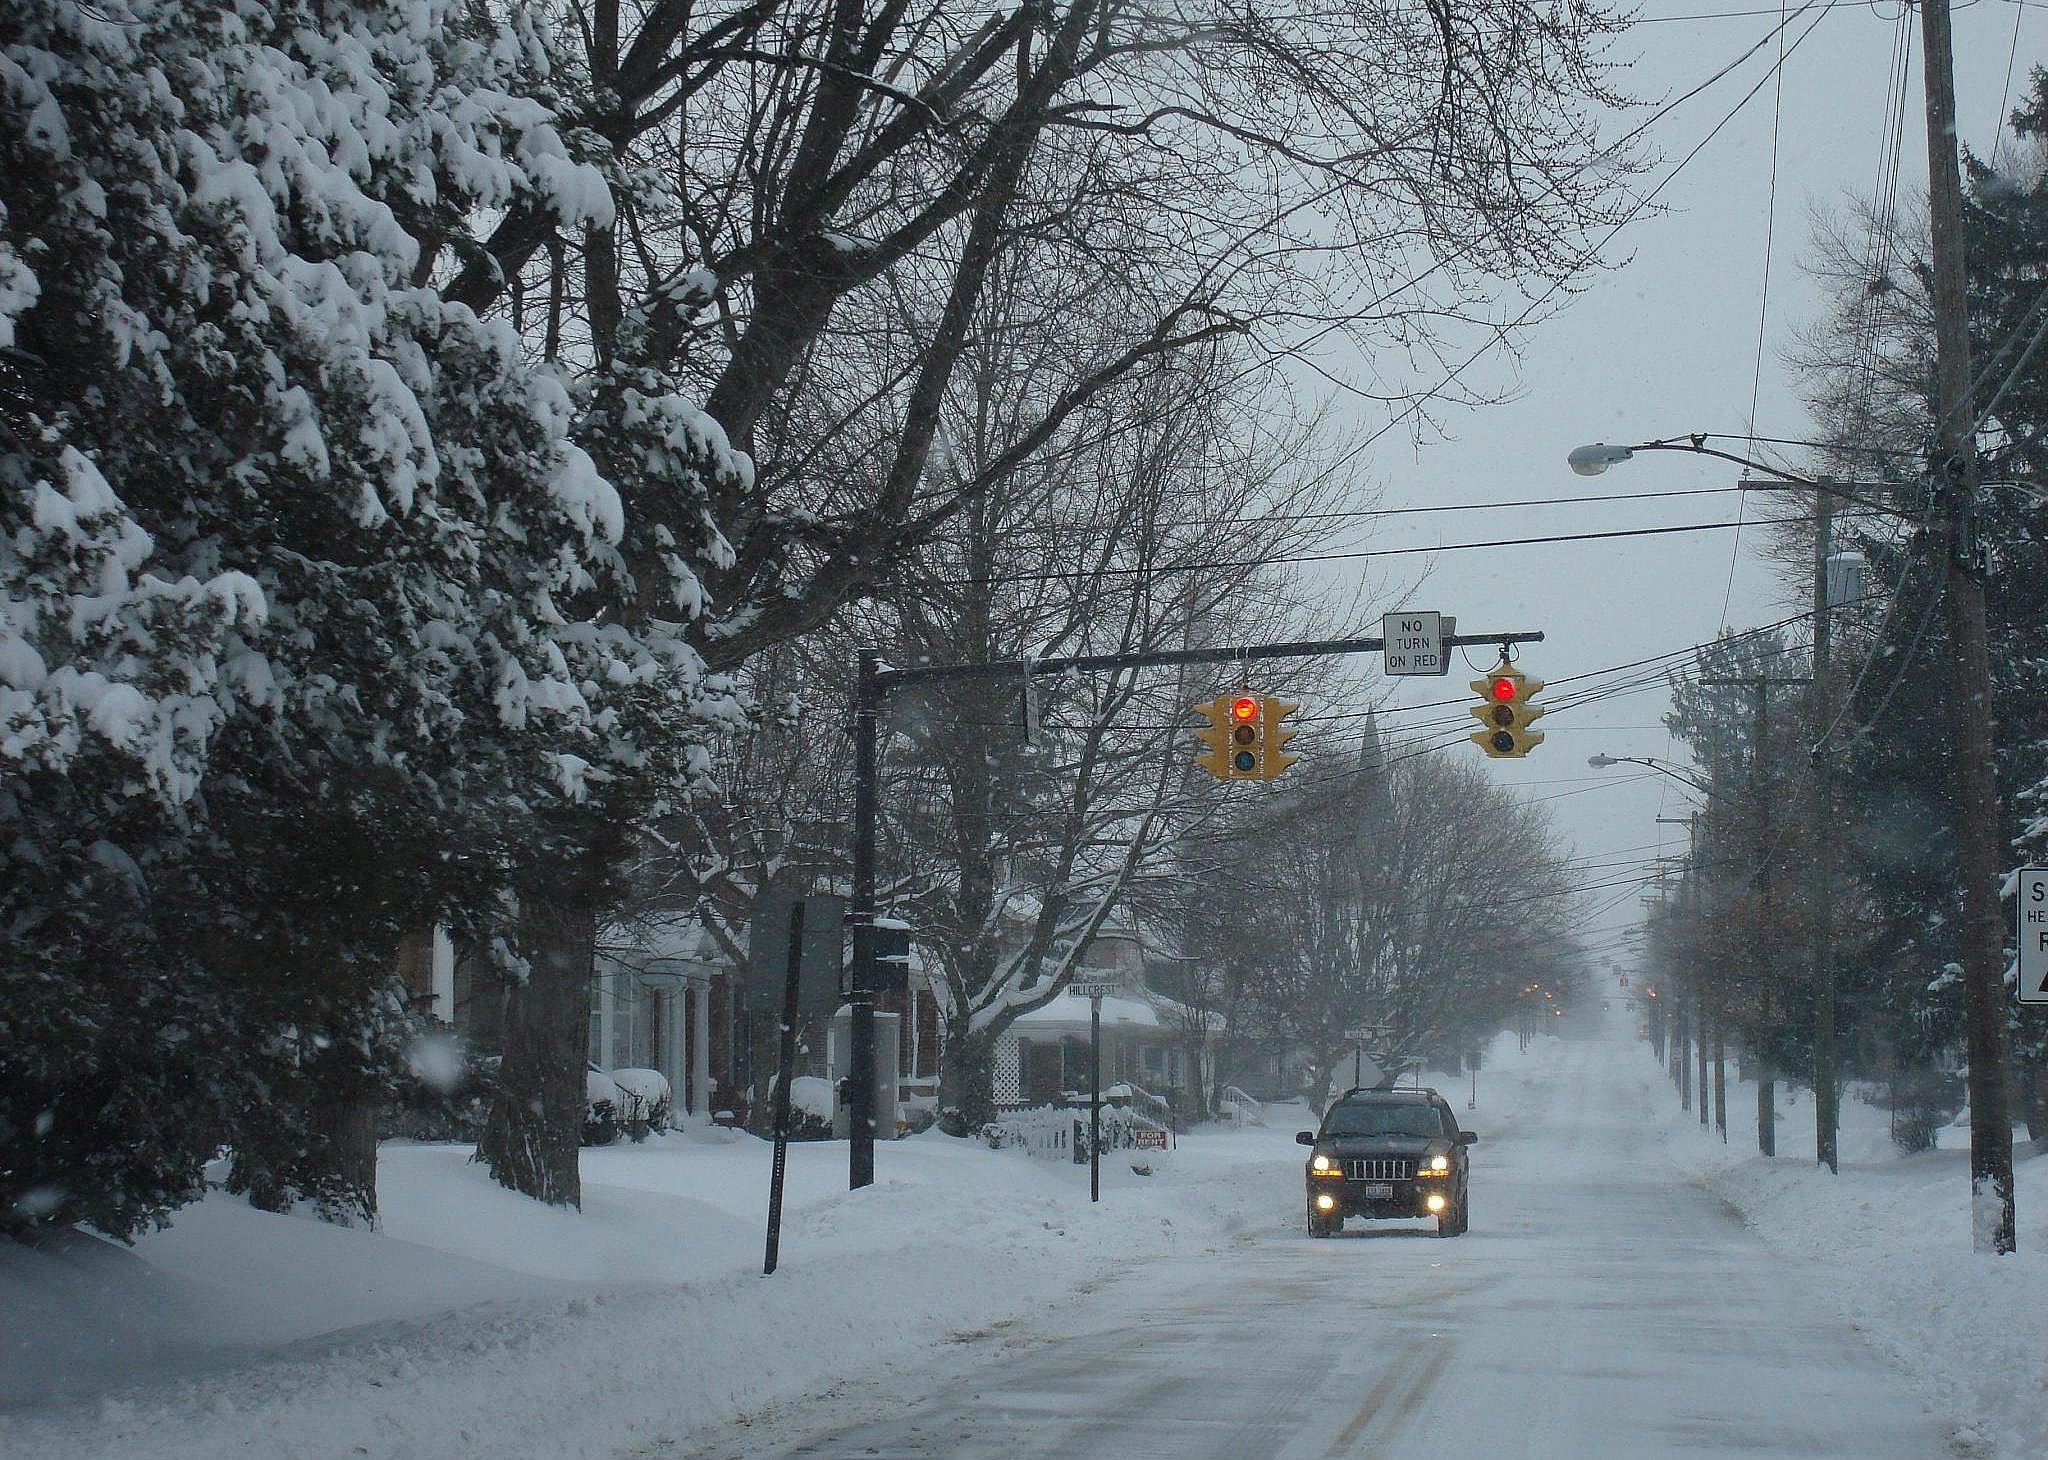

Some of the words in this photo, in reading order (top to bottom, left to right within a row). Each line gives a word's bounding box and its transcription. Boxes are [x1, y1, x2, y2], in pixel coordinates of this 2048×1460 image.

[1401, 620, 1422, 632] NO
[1396, 637, 1430, 650] TURN
[1389, 656, 1406, 667] ON
[1414, 654, 1437, 666] RED
[1069, 985, 1115, 996] HILLCREST
